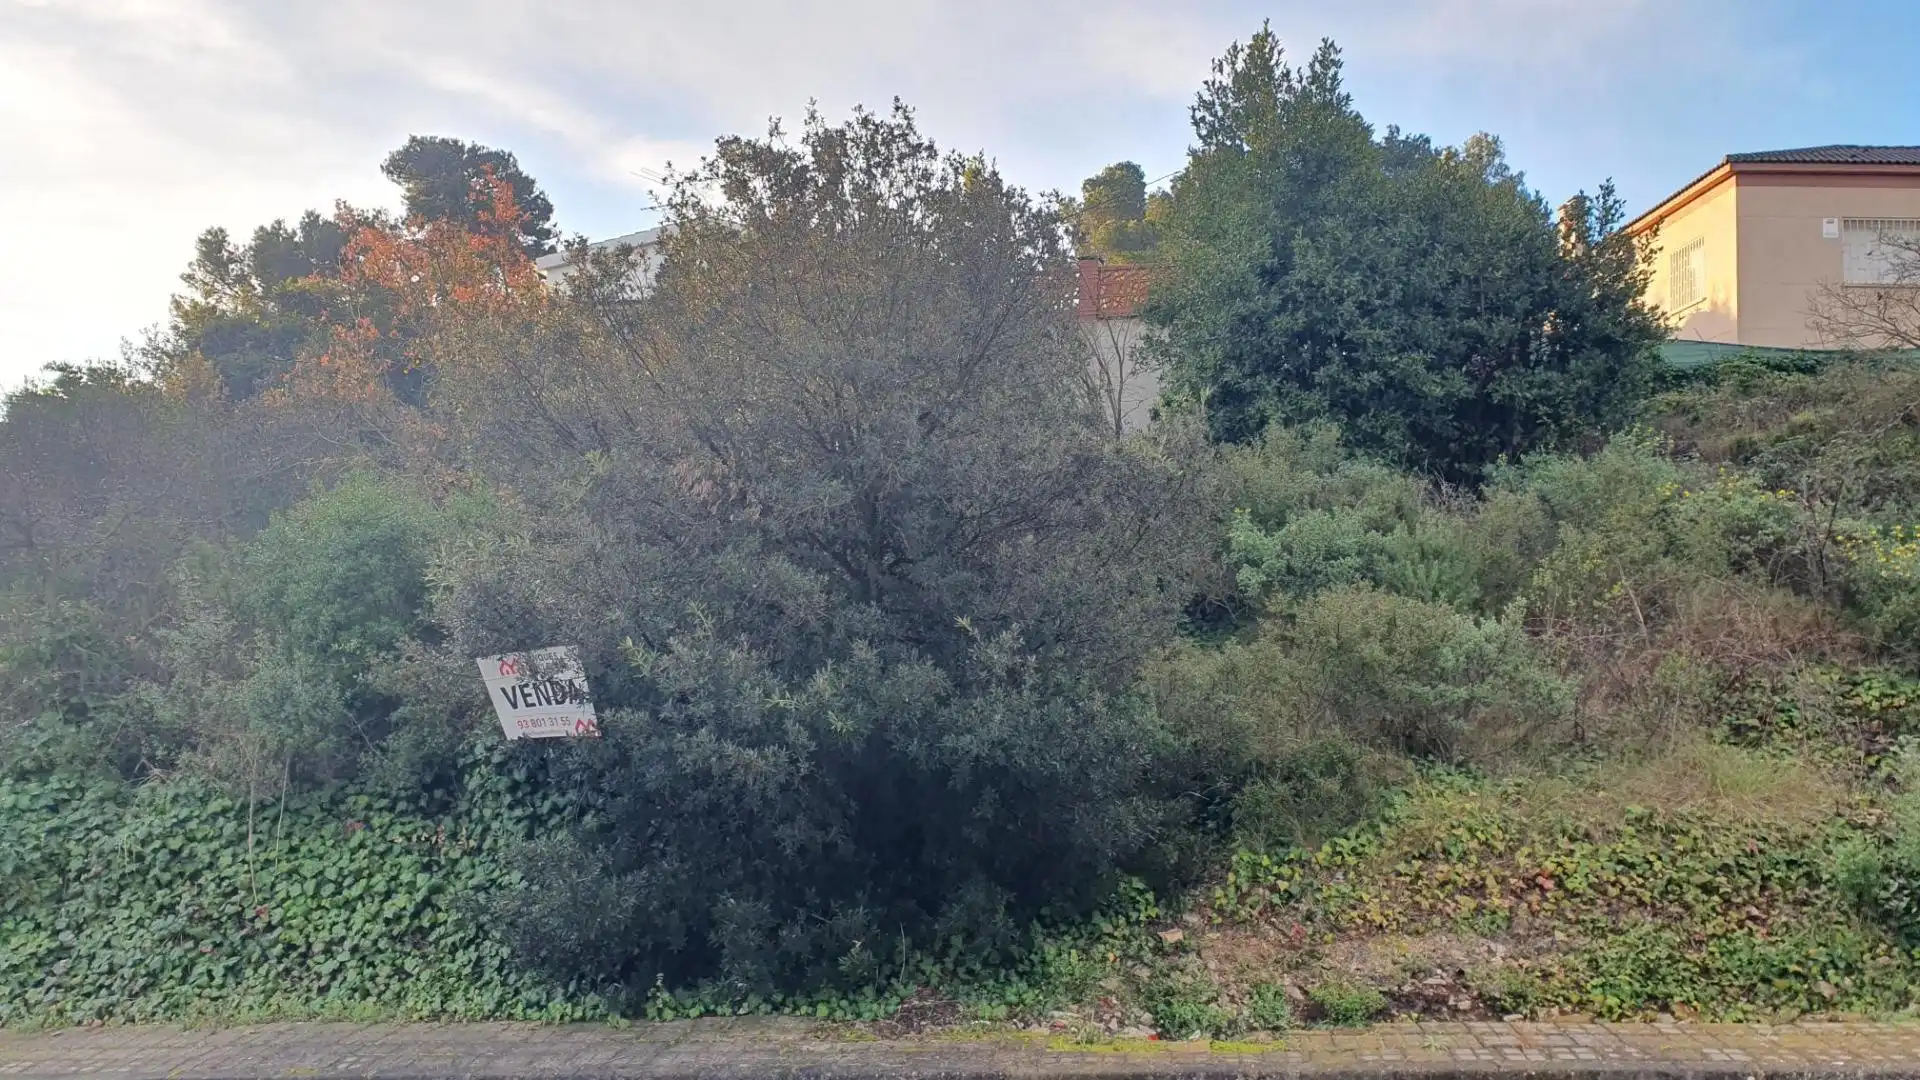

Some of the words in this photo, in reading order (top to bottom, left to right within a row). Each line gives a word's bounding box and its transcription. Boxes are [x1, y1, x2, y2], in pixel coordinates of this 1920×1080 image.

[500, 679, 583, 710] VENDA
[517, 719, 529, 730] 93
[530, 717, 547, 728] 801
[548, 716, 559, 727] 31
[560, 716, 571, 726] 55
